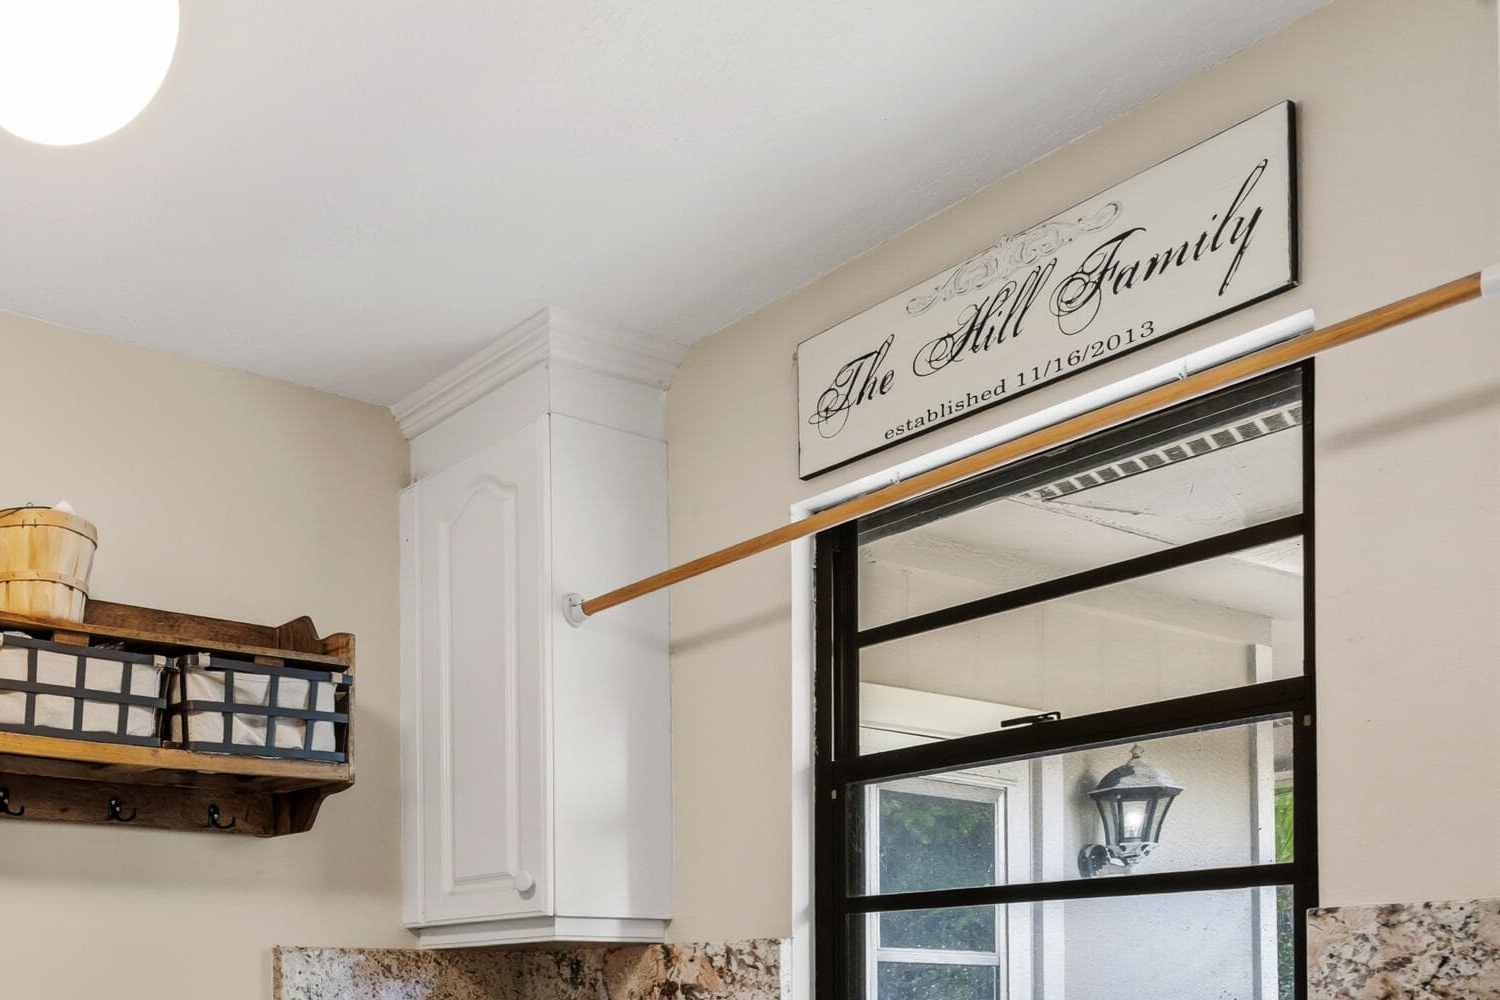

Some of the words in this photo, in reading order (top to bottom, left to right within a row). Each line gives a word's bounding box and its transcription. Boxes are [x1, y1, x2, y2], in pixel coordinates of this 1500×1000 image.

[808, 333, 896, 440] The
[912, 257, 1058, 377] Hill
[1048, 157, 1269, 336] Family
[883, 378, 1007, 441] established
[1016, 319, 1156, 389] 11/16/2013
